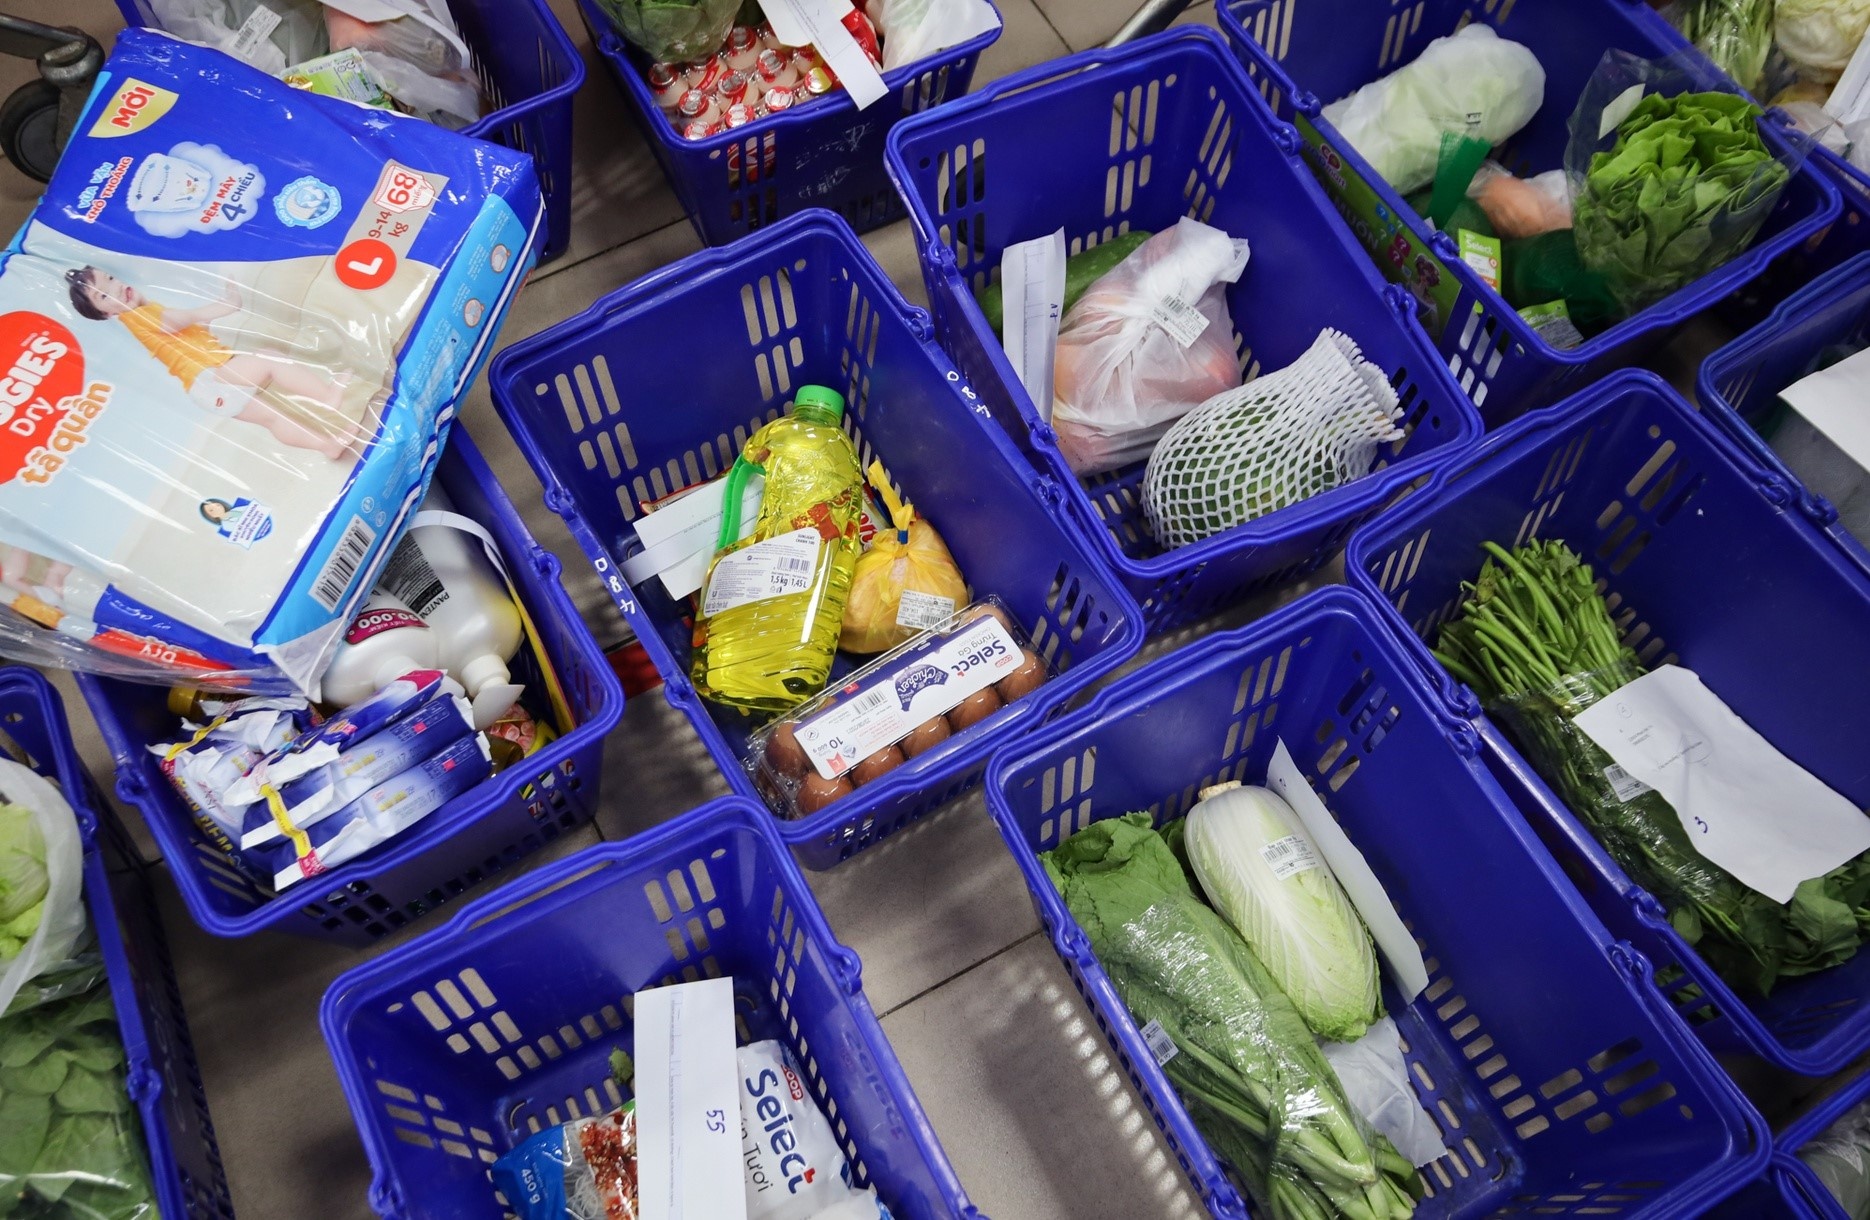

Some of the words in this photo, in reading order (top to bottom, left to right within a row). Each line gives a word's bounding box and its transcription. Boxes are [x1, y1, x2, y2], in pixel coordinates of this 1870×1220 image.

[110, 86, 156, 129] MỚI
[78, 185, 99, 209] VỪA
[85, 199, 107, 224] KHÔ
[102, 156, 134, 199] THOÁNG
[200, 201, 222, 224] ĐỆM
[217, 176, 237, 200] MÂY
[230, 172, 256, 203] CHIỀU
[387, 172, 418, 206] 68
[221, 203, 247, 222] 4
[368, 211, 392, 239] 9-14
[388, 222, 409, 237] kg
[347, 257, 384, 276] L
[9, 397, 54, 437] Dry
[22, 450, 64, 484] tã
[52, 383, 112, 452] quần
[770, 575, 780, 584] 1,5
[780, 576, 788, 586] kg
[791, 578, 803, 588] 1,45
[418, 593, 450, 619] PANTEN
[970, 630, 997, 650] Trứng
[140, 644, 177, 663] Dry
[951, 640, 1006, 677] Select
[994, 654, 1013, 668] COOP
[898, 667, 936, 692] Chicken
[829, 736, 844, 749] 10
[706, 1109, 726, 1135] 55
[746, 1069, 815, 1194] Select
[519, 1166, 538, 1192] 450
[744, 1143, 774, 1193] Tươi
[528, 1193, 541, 1204] g
